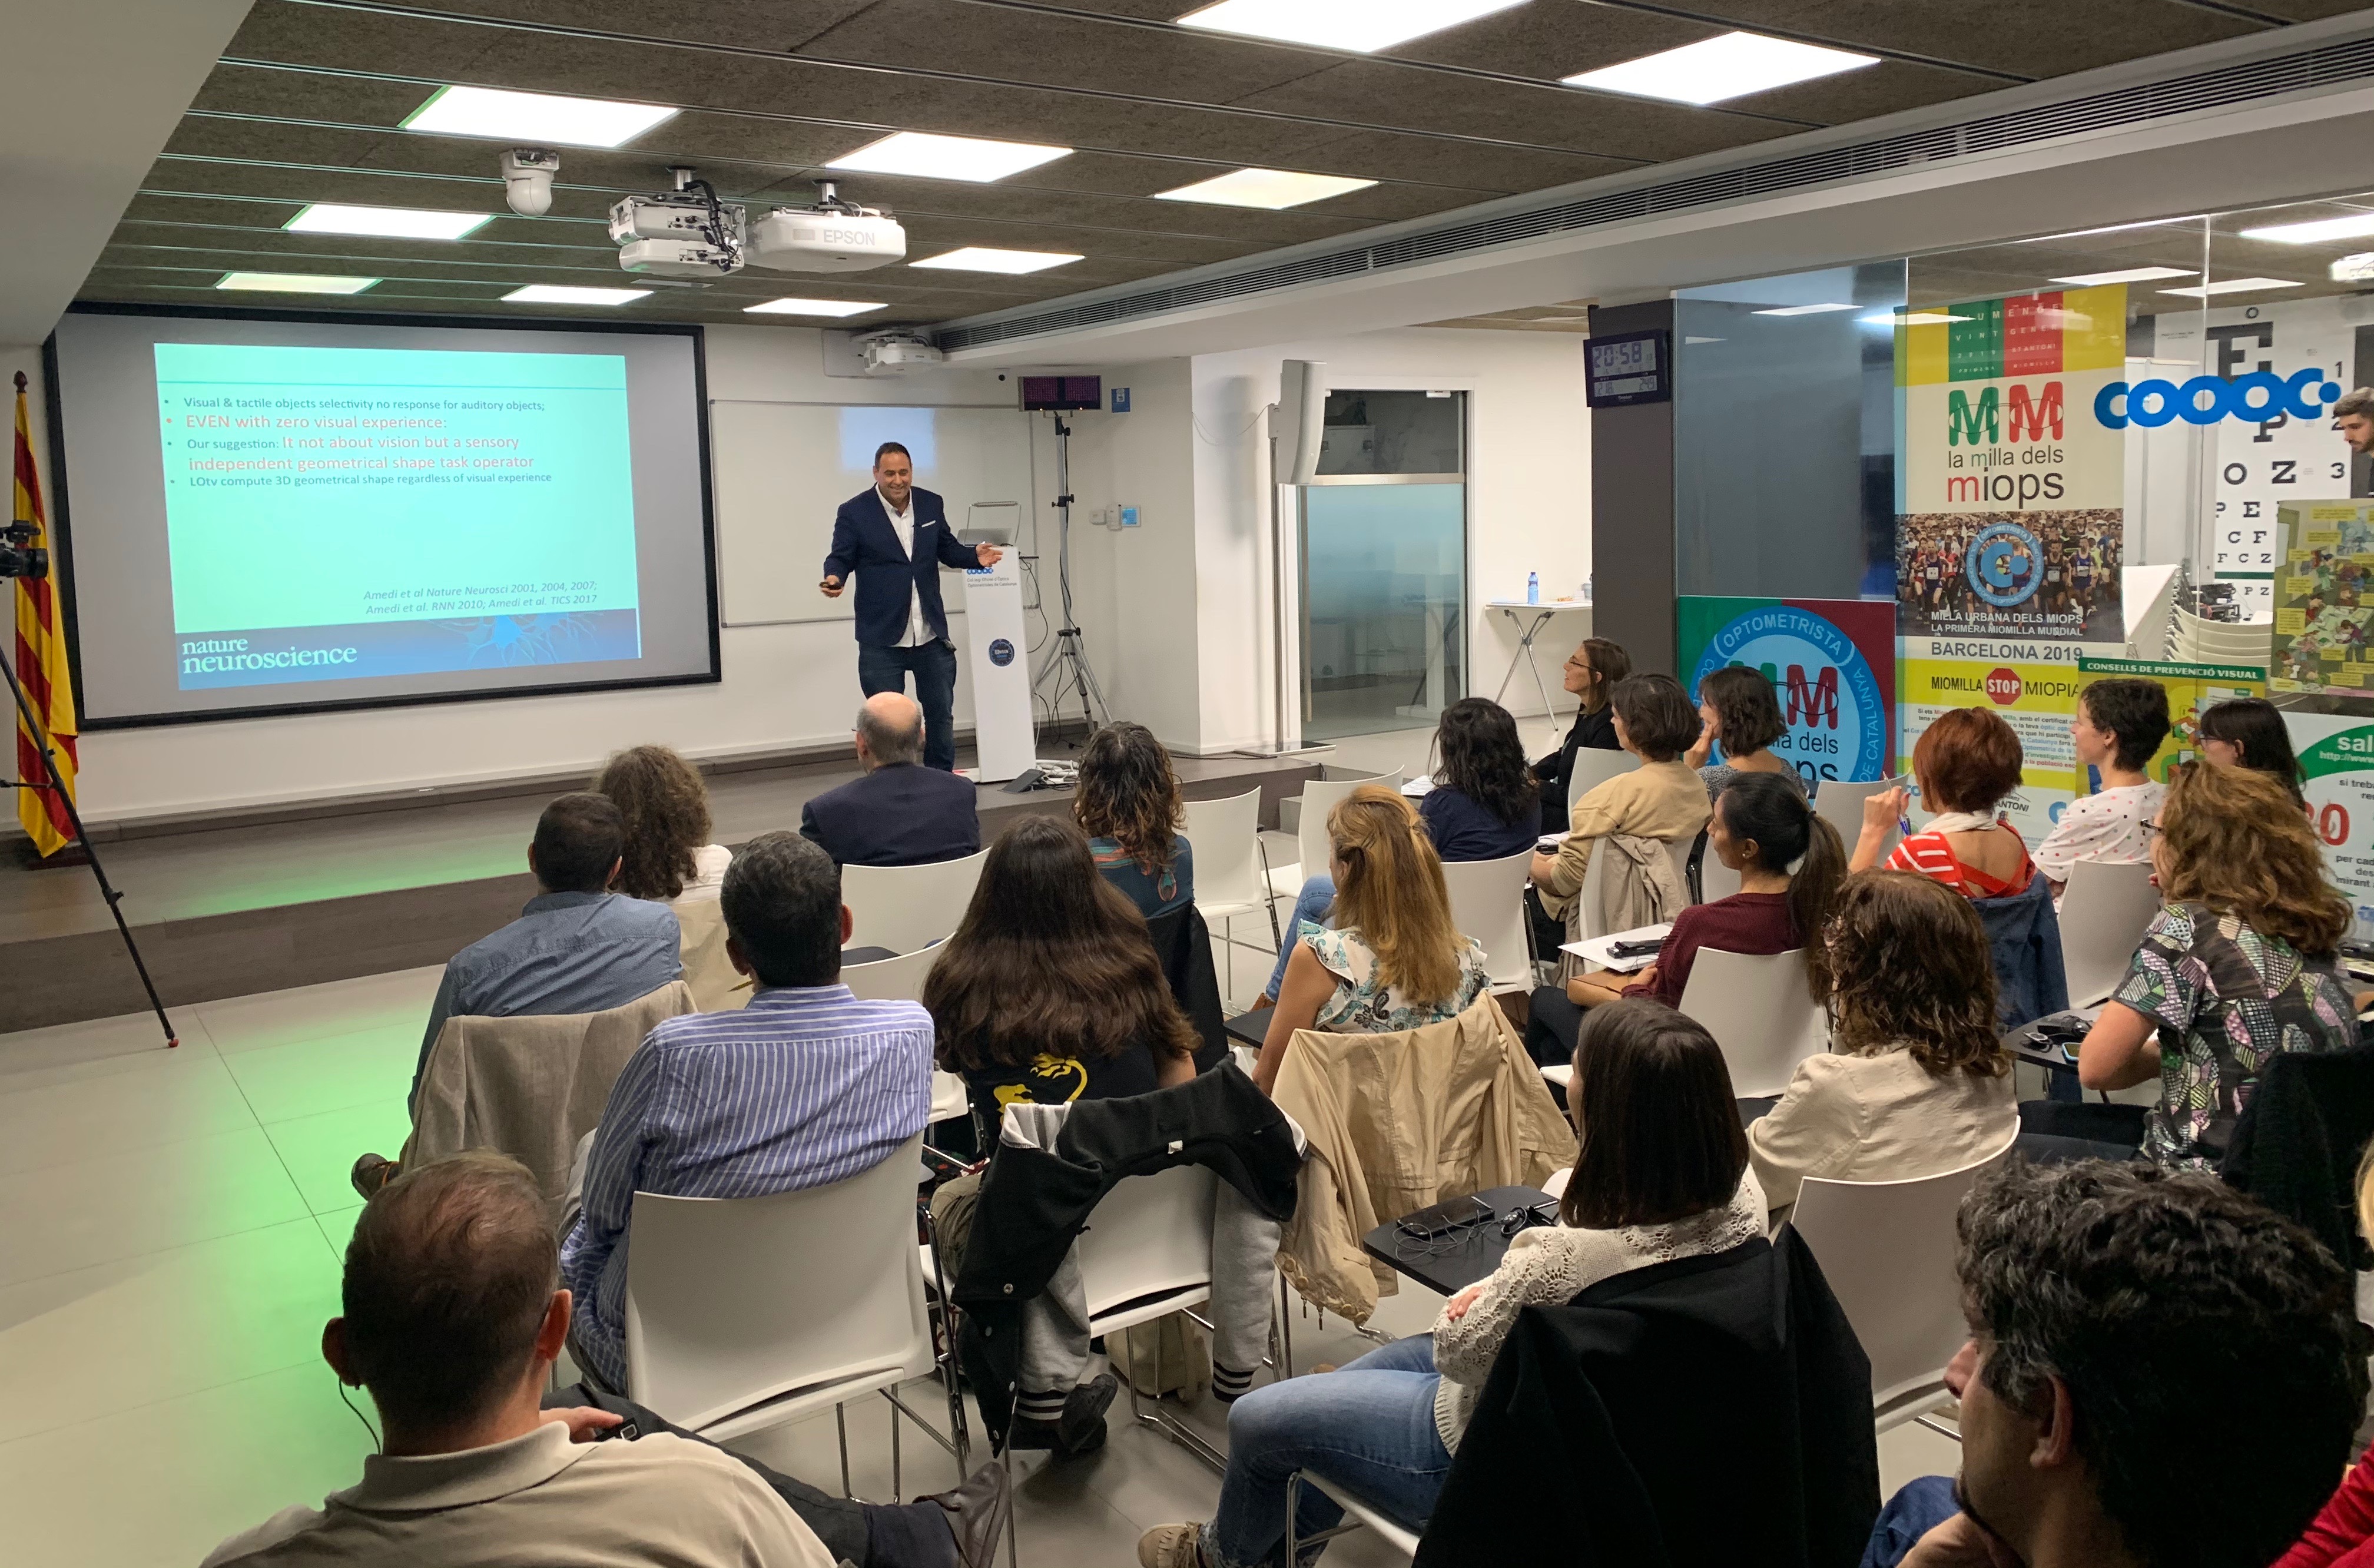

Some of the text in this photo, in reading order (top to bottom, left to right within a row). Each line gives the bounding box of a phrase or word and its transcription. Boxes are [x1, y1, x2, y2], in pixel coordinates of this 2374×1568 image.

[823, 229, 876, 246] EPSON
[1956, 324, 2058, 341] VINT GENER
[1591, 342, 1642, 368] 20:58
[2335, 360, 2343, 378] 1
[183, 397, 545, 412] Visual & tactile objects selectivity no response for auditory objects;
[185, 415, 447, 430] EVEN with zero visual experience:
[1948, 381, 2064, 447] MM
[187, 436, 519, 451] Our suggestion: It not about vision but a sensory
[188, 456, 535, 473] independent geometrical shape task operator
[1948, 445, 2064, 468] la milla dels
[190, 473, 552, 488] LOtv compute 3D geometrical shape regardless of visual experience
[2224, 460, 2346, 485] O Z 3
[1948, 467, 2065, 509] miops
[2243, 501, 2260, 518] E
[1981, 525, 2028, 539] OPTOMETRISTA
[2228, 531, 2267, 544] C F
[2217, 553, 2272, 563] F C Z
[363, 581, 598, 601] Amedi et al Nature Neurosci 2001, 2004, 2007;
[2244, 586, 2270, 595] P Z
[366, 594, 597, 615] Amedi et al. RNN 2010; Amedi et al. TICS 2017
[1931, 611, 2083, 625] MILLA URBANA DELS MIOPS
[1723, 614, 1842, 656] OPTOMETRISTA
[1931, 624, 2083, 637] LA PRIMERA MIOMILLA MUNDIAL
[181, 638, 248, 655] nature
[1931, 641, 2083, 661] BARCELONA 2019
[183, 646, 357, 674] neuroscience
[2087, 662, 2137, 672] CONSELLS
[2154, 666, 2216, 677] PREVENCIÓ
[2217, 669, 2259, 679] VISUAL
[1931, 676, 1983, 692] MIOMILLA
[1988, 679, 2020, 694] STOP
[1854, 667, 1879, 783] DE CATALUNYA
[1799, 731, 1839, 754] dels
[2336, 855, 2353, 863] per
[2336, 877, 2370, 888] mirant
